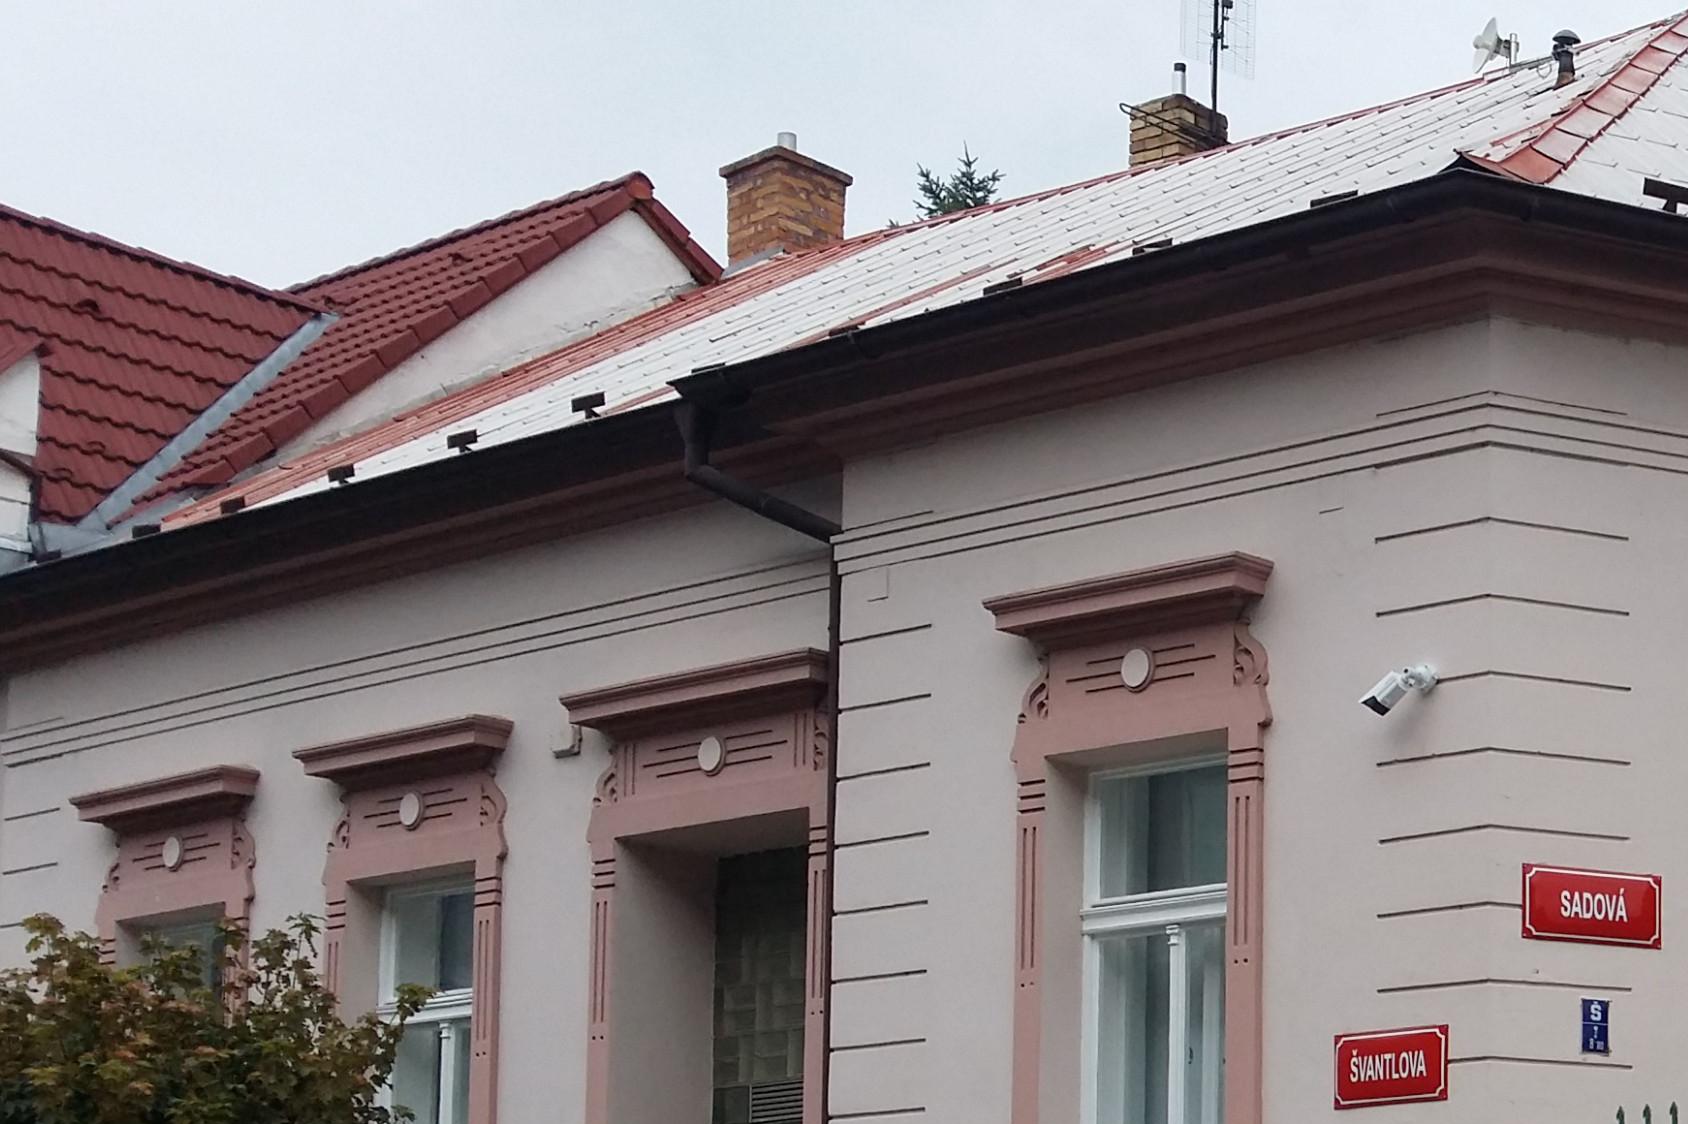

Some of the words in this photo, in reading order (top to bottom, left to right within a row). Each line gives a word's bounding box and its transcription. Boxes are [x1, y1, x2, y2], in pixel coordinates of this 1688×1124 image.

[1560, 888, 1628, 922] SADOVÁ
[1590, 1001, 1602, 1021] Š
[1350, 1049, 1427, 1083] ŠVANTLOVA
